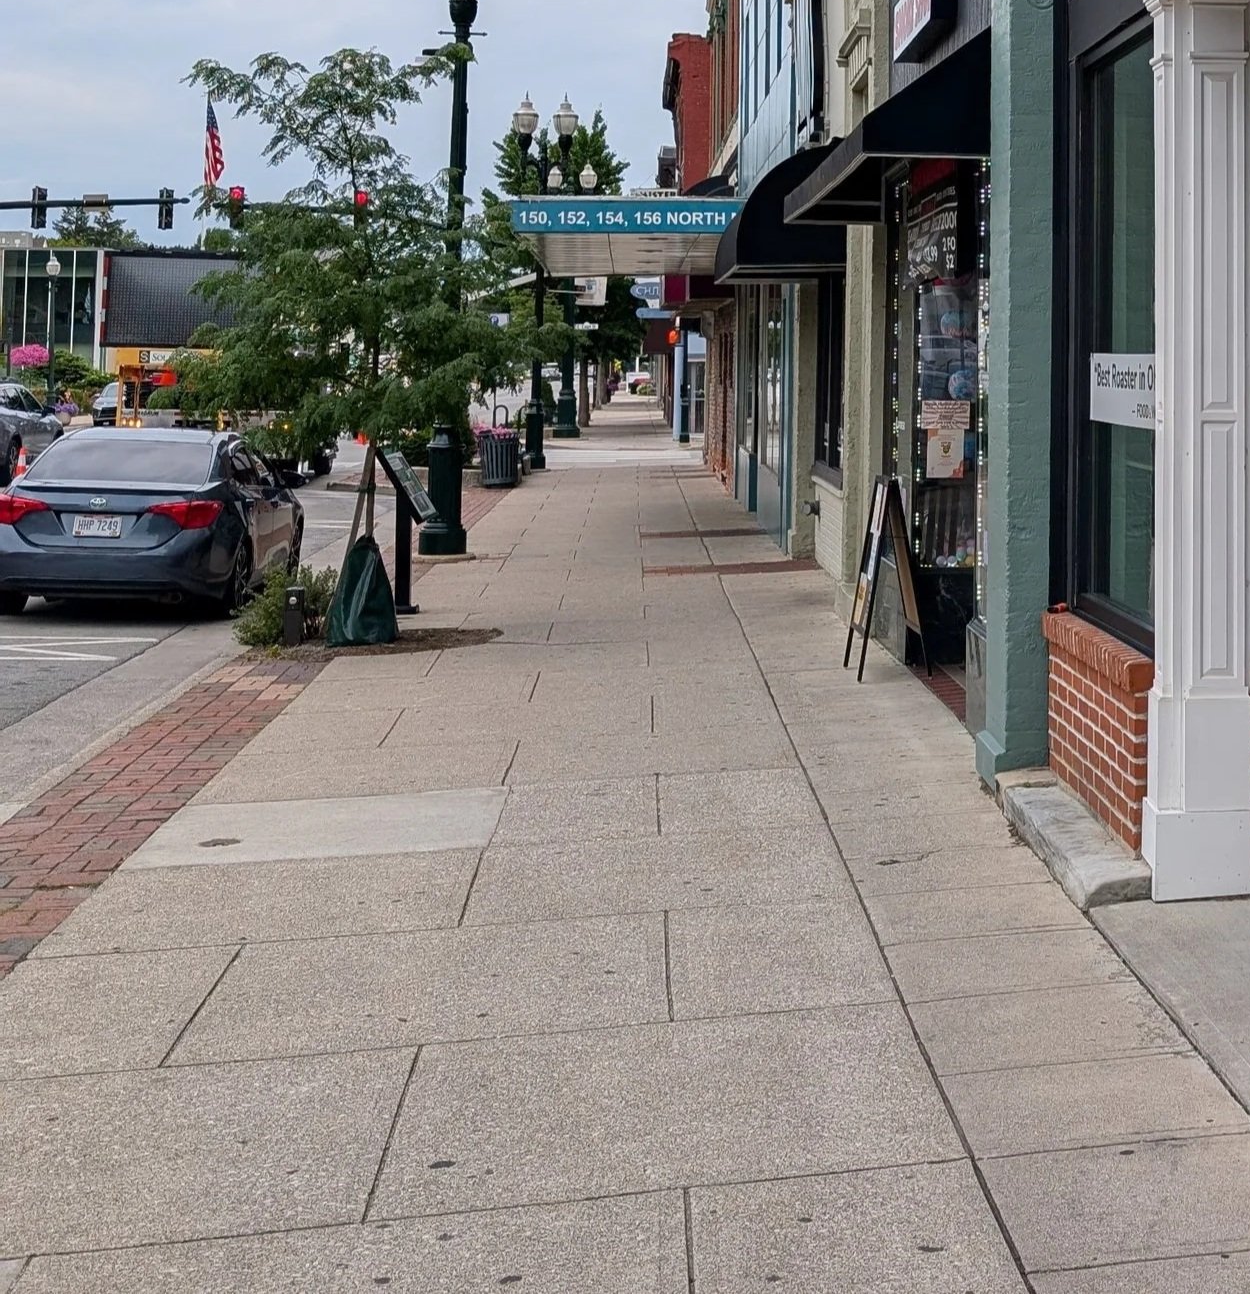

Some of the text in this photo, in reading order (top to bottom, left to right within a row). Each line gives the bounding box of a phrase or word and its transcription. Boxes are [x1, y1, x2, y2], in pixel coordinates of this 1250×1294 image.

[519, 211, 551, 227] 150,
[557, 211, 590, 227] 152,
[596, 211, 628, 227] 154,
[634, 211, 662, 225] 156
[667, 211, 726, 225] NORTH
[1112, 363, 1138, 390] Roaster
[1139, 363, 1146, 390] in
[78, 519, 118, 532] HHP 7249
